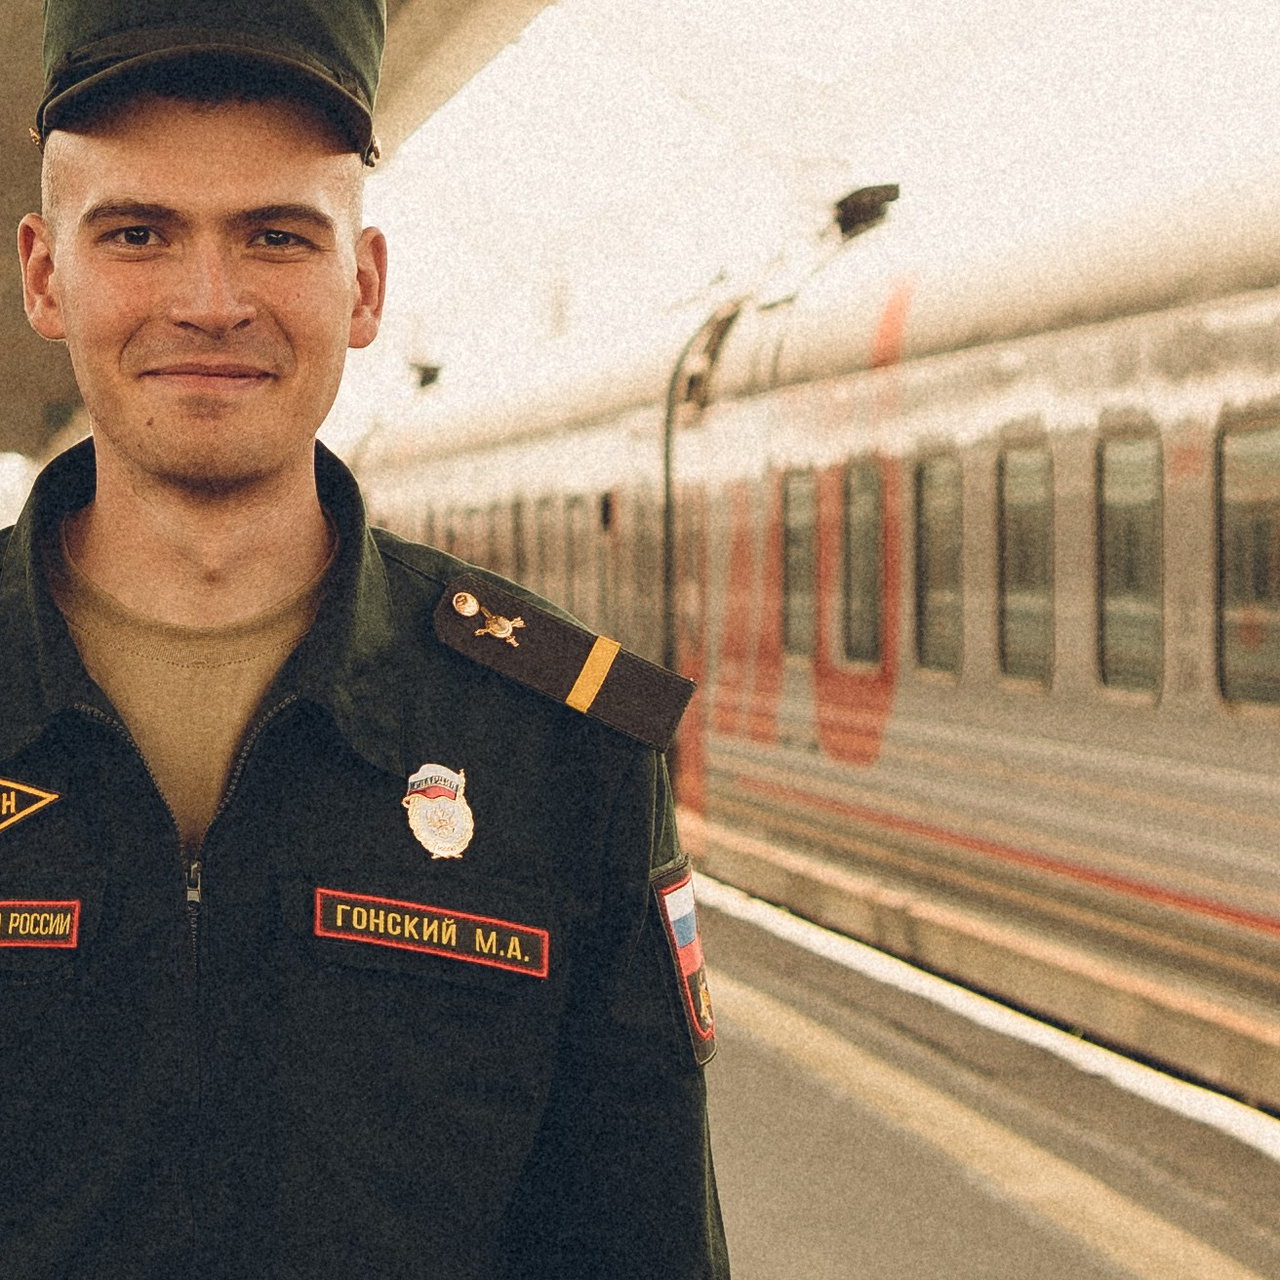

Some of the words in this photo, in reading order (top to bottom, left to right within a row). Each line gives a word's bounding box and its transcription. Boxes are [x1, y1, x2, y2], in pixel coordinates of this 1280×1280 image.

[8, 913, 71, 935] РОССИИ
[336, 904, 457, 946] ГОНСКИЙ
[475, 928, 530, 962] М.А.
